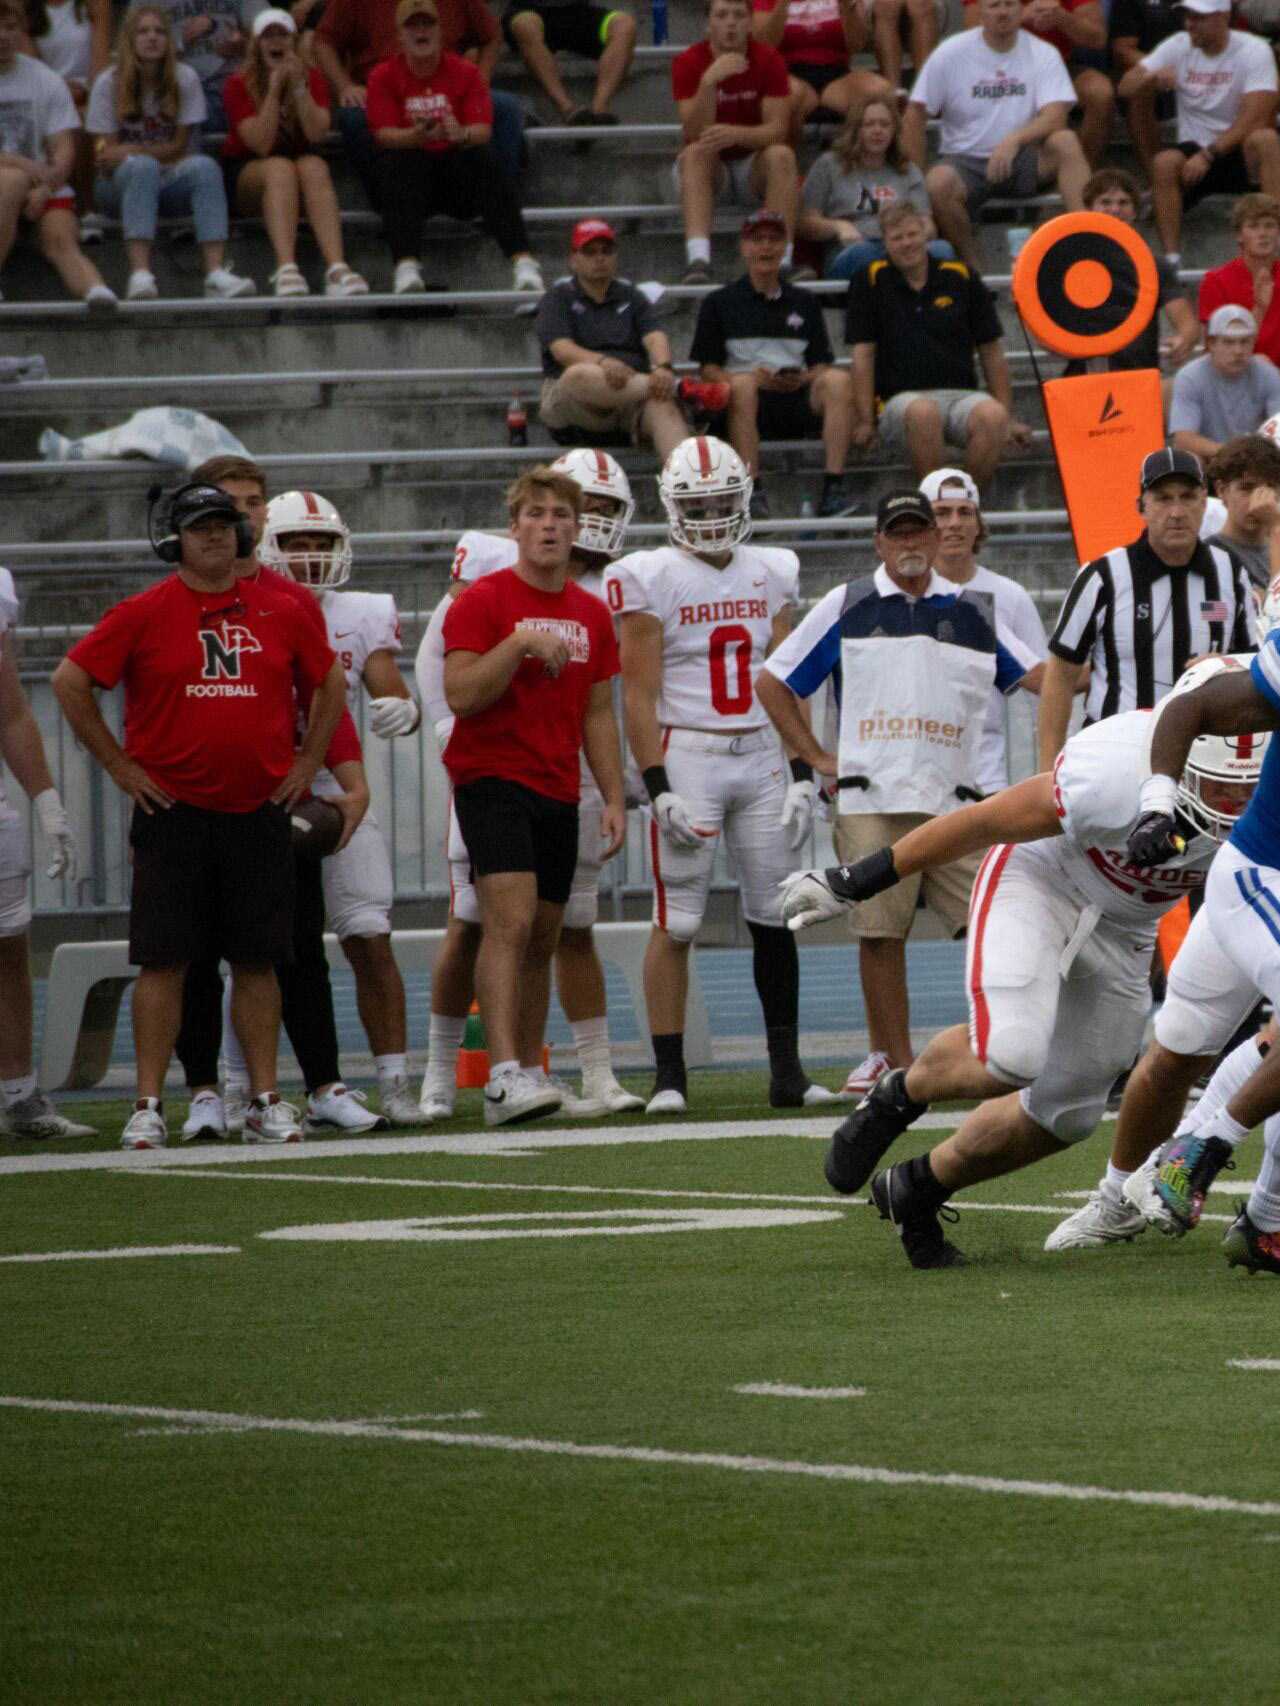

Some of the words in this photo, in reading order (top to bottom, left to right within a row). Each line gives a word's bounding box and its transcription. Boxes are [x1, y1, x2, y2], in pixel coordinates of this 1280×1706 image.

[607, 578, 624, 611] 0
[679, 600, 768, 625] RAIDERS
[1137, 603, 1150, 619] S
[709, 624, 754, 716] 0
[186, 685, 258, 697] FOOTBALL
[858, 709, 966, 744] pioneer
